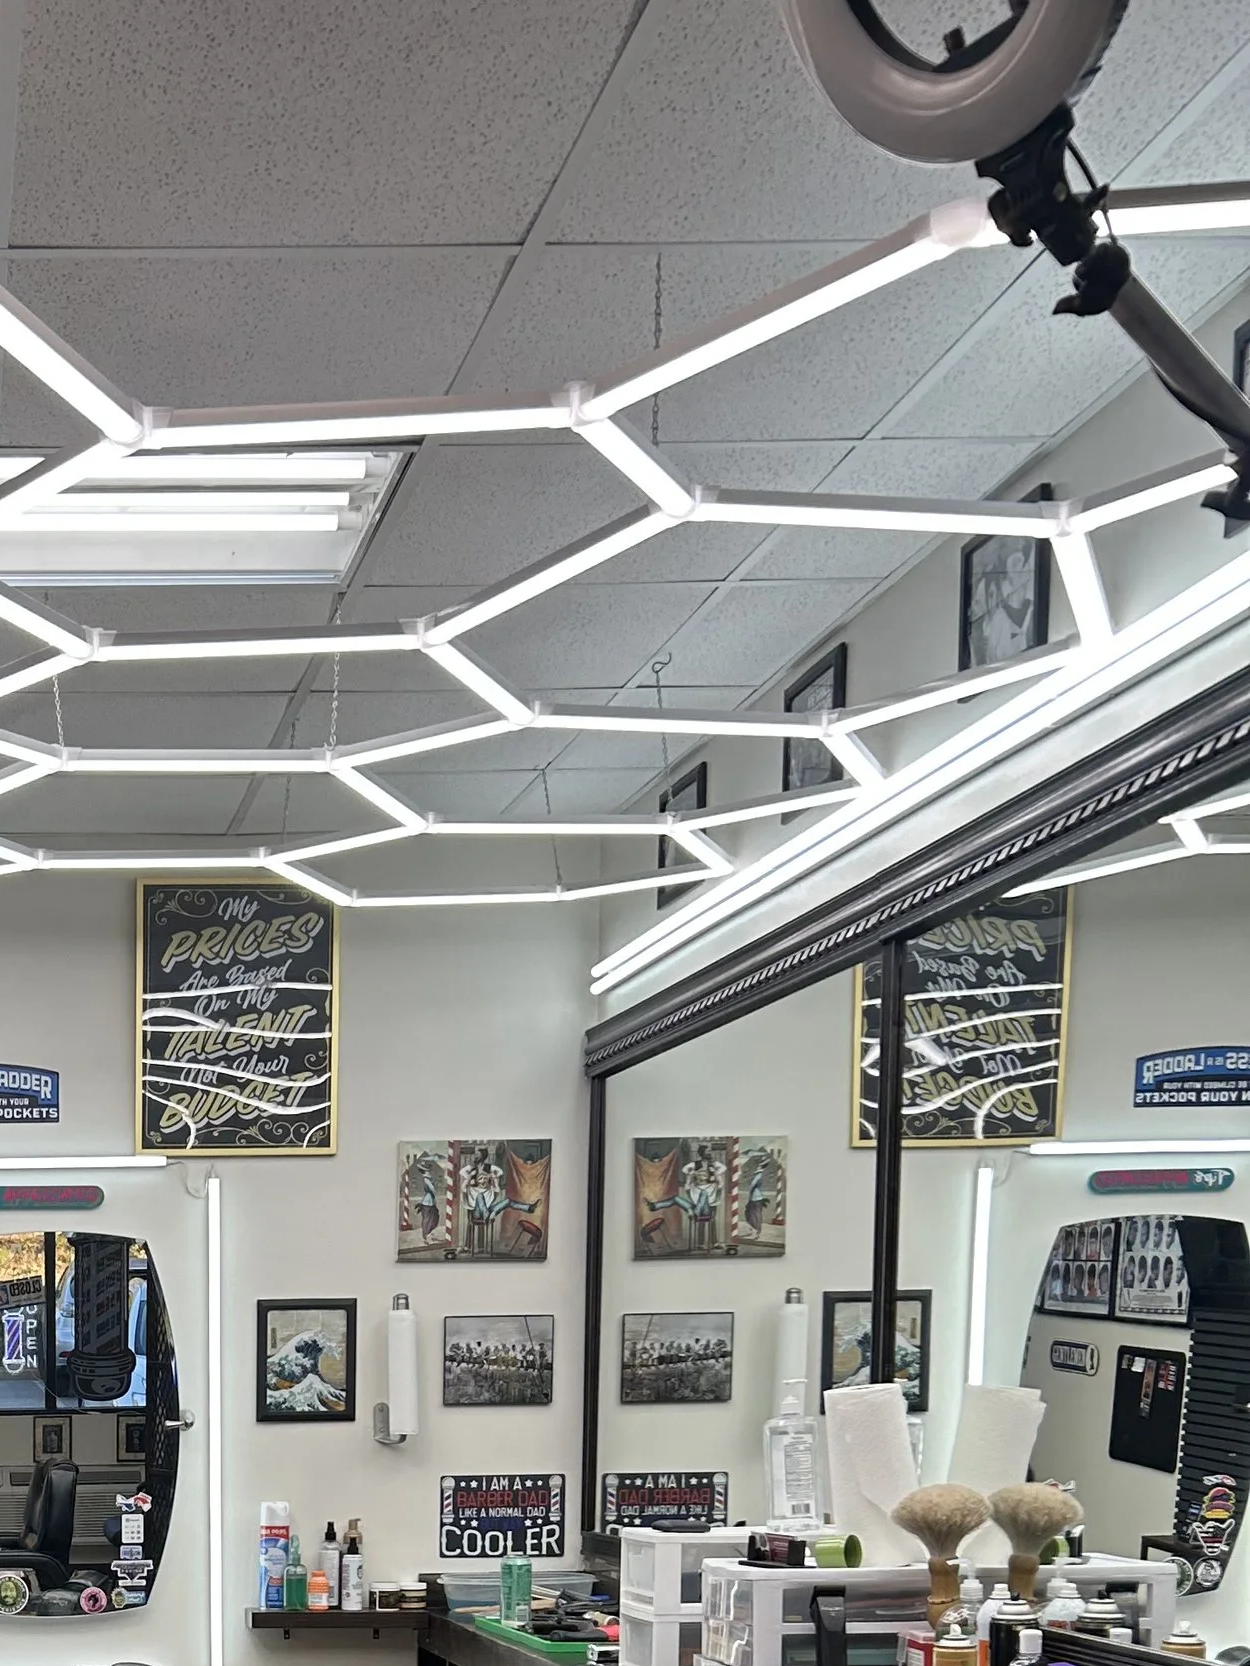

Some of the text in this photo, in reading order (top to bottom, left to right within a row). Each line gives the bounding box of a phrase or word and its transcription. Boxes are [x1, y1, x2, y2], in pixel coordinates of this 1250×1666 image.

[218, 896, 260, 922] My
[160, 912, 324, 973] PRICES
[179, 958, 292, 992] Are Based
[193, 986, 278, 1016] On My
[164, 1004, 317, 1062] TALENT
[180, 1054, 289, 1085] Not Your
[10, 1098, 29, 1106] YOUR
[159, 1072, 319, 1133] BUDGET
[457, 1490, 549, 1507] BARBER DAD
[482, 1476, 522, 1491] I AM A
[459, 1507, 546, 1518] LIKE A NORMAL DAD
[441, 1524, 560, 1556] COOLER
